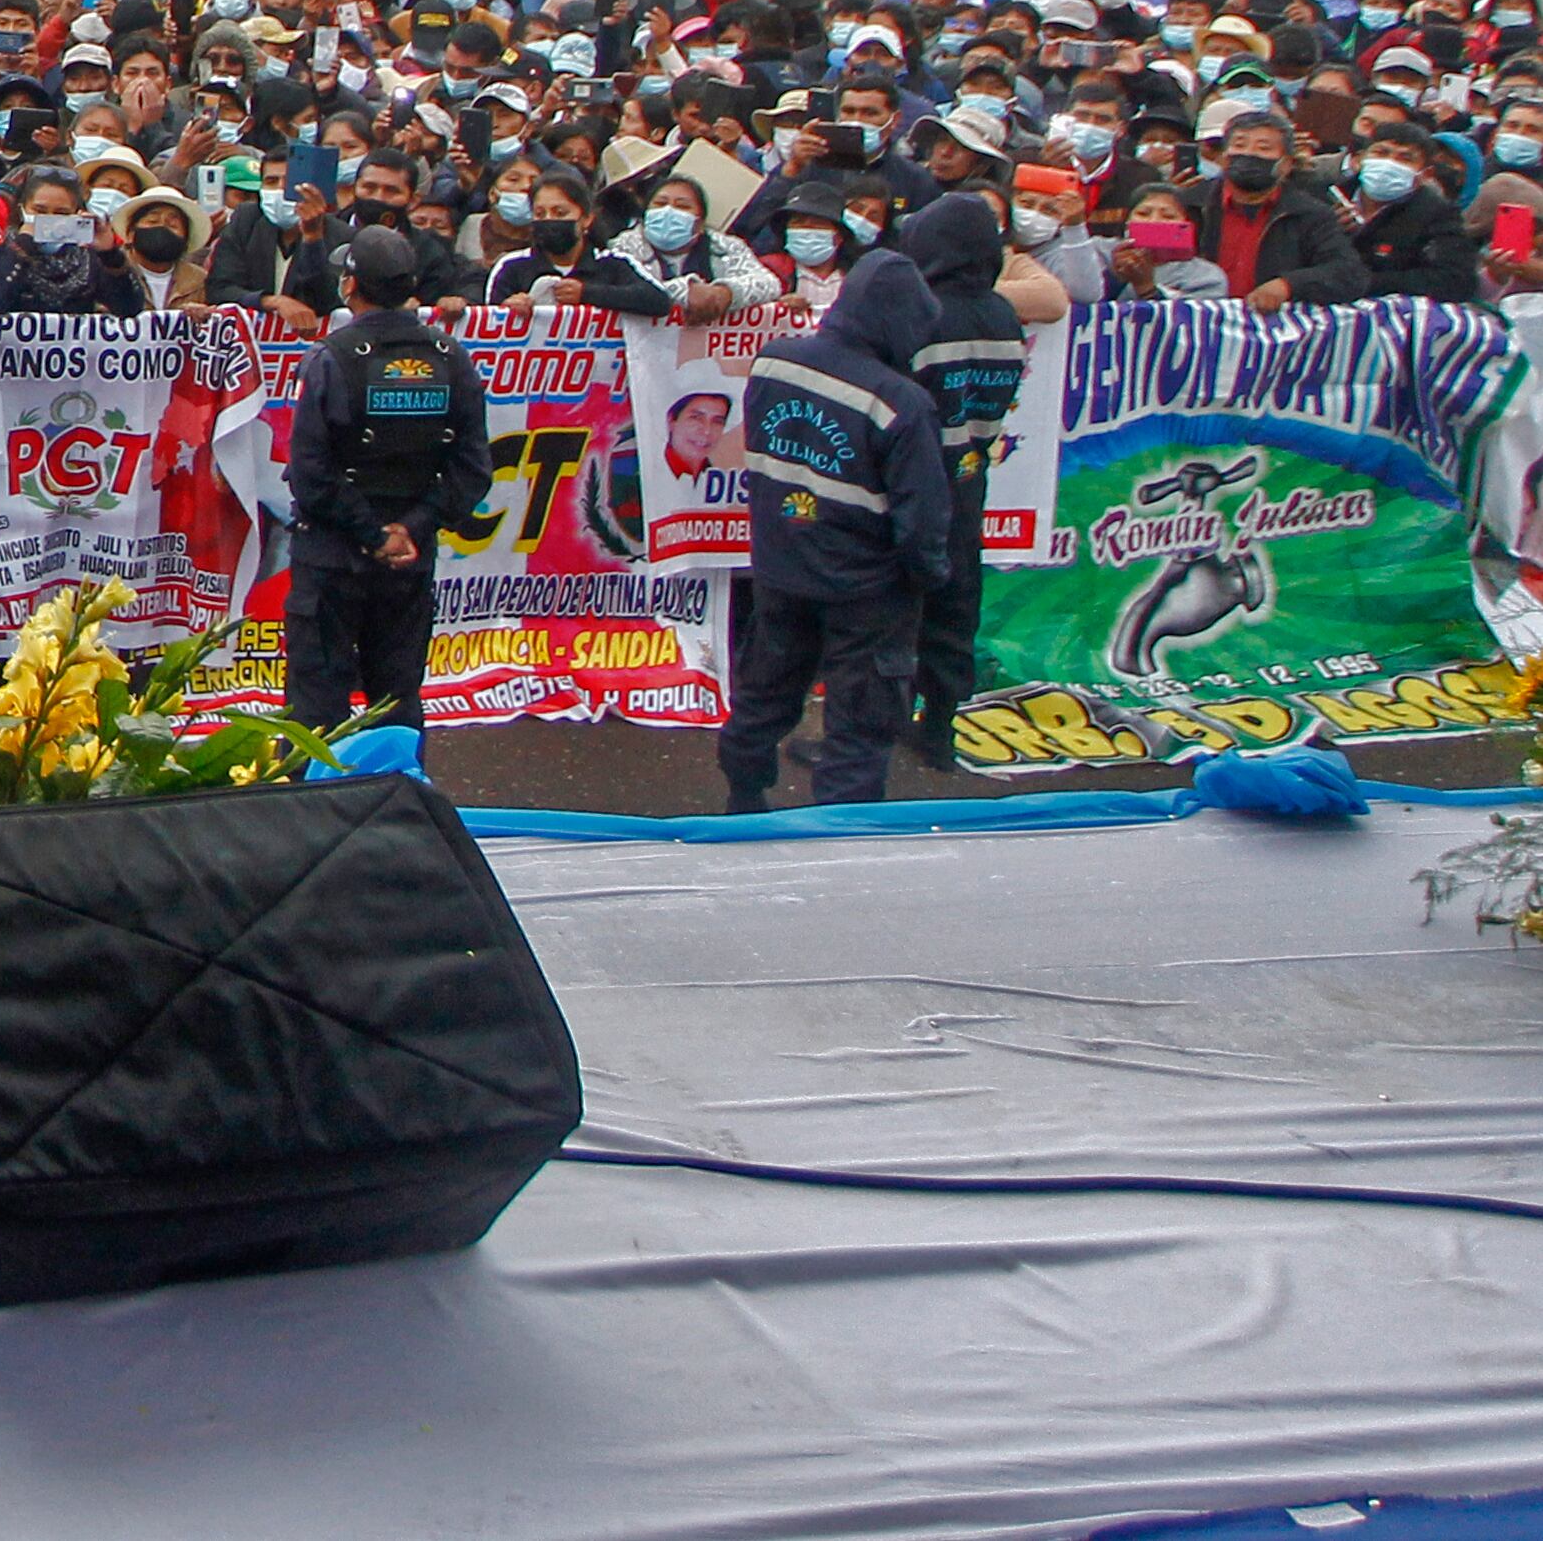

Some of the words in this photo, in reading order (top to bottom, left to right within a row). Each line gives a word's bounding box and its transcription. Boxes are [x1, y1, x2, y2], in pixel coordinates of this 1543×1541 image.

[97, 346, 183, 381] COMO
[1062, 299, 1219, 434] GESTION
[372, 390, 446, 411] SERENAZGO
[92, 533, 121, 555] JULI
[463, 574, 497, 620] SAN
[496, 573, 556, 619] PEDRO
[556, 574, 584, 619] DE
[569, 627, 678, 670] SANDIA
[1312, 653, 1383, 680] 1995
[627, 682, 719, 717] POPULAR
